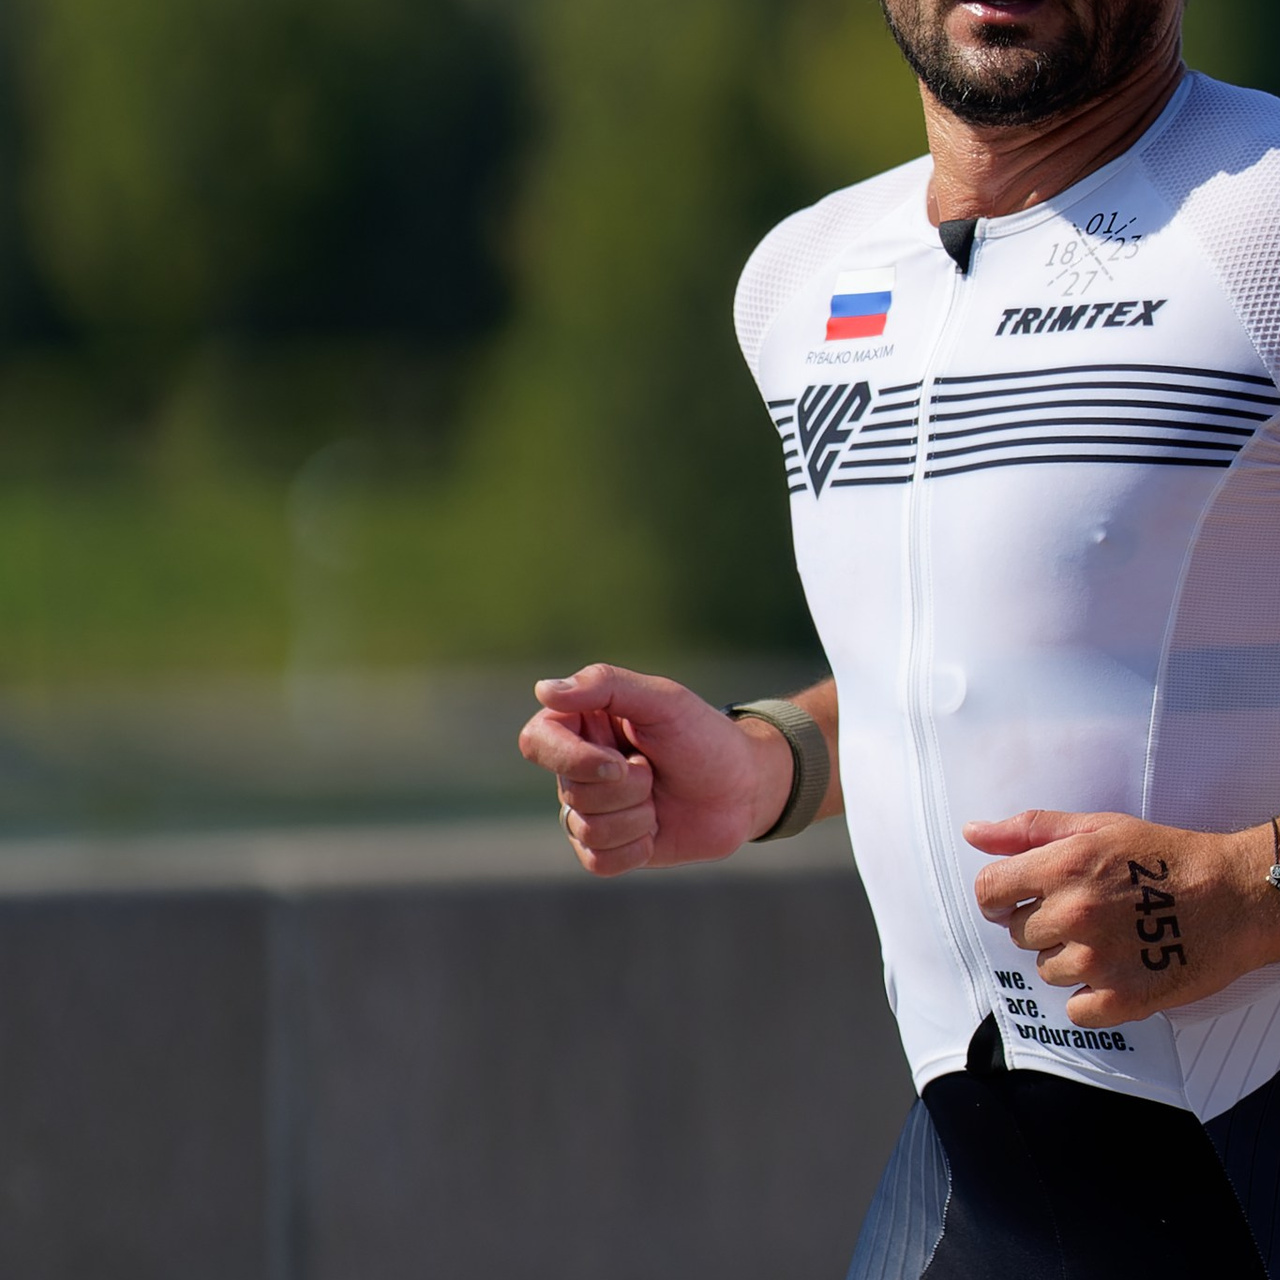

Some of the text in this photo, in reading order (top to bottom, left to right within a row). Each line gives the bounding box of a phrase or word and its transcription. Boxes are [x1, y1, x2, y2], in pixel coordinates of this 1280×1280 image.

[1086, 212, 1118, 235] 01
[1045, 235, 1142, 267] 18 23
[1061, 270, 1098, 296] 27
[995, 299, 1168, 336] TRIMTEX
[806, 344, 894, 364] RYBALKO MAXIM
[1128, 860, 1187, 971] 2455
[995, 971, 1033, 990] we.
[1006, 998, 1046, 1019] are.
